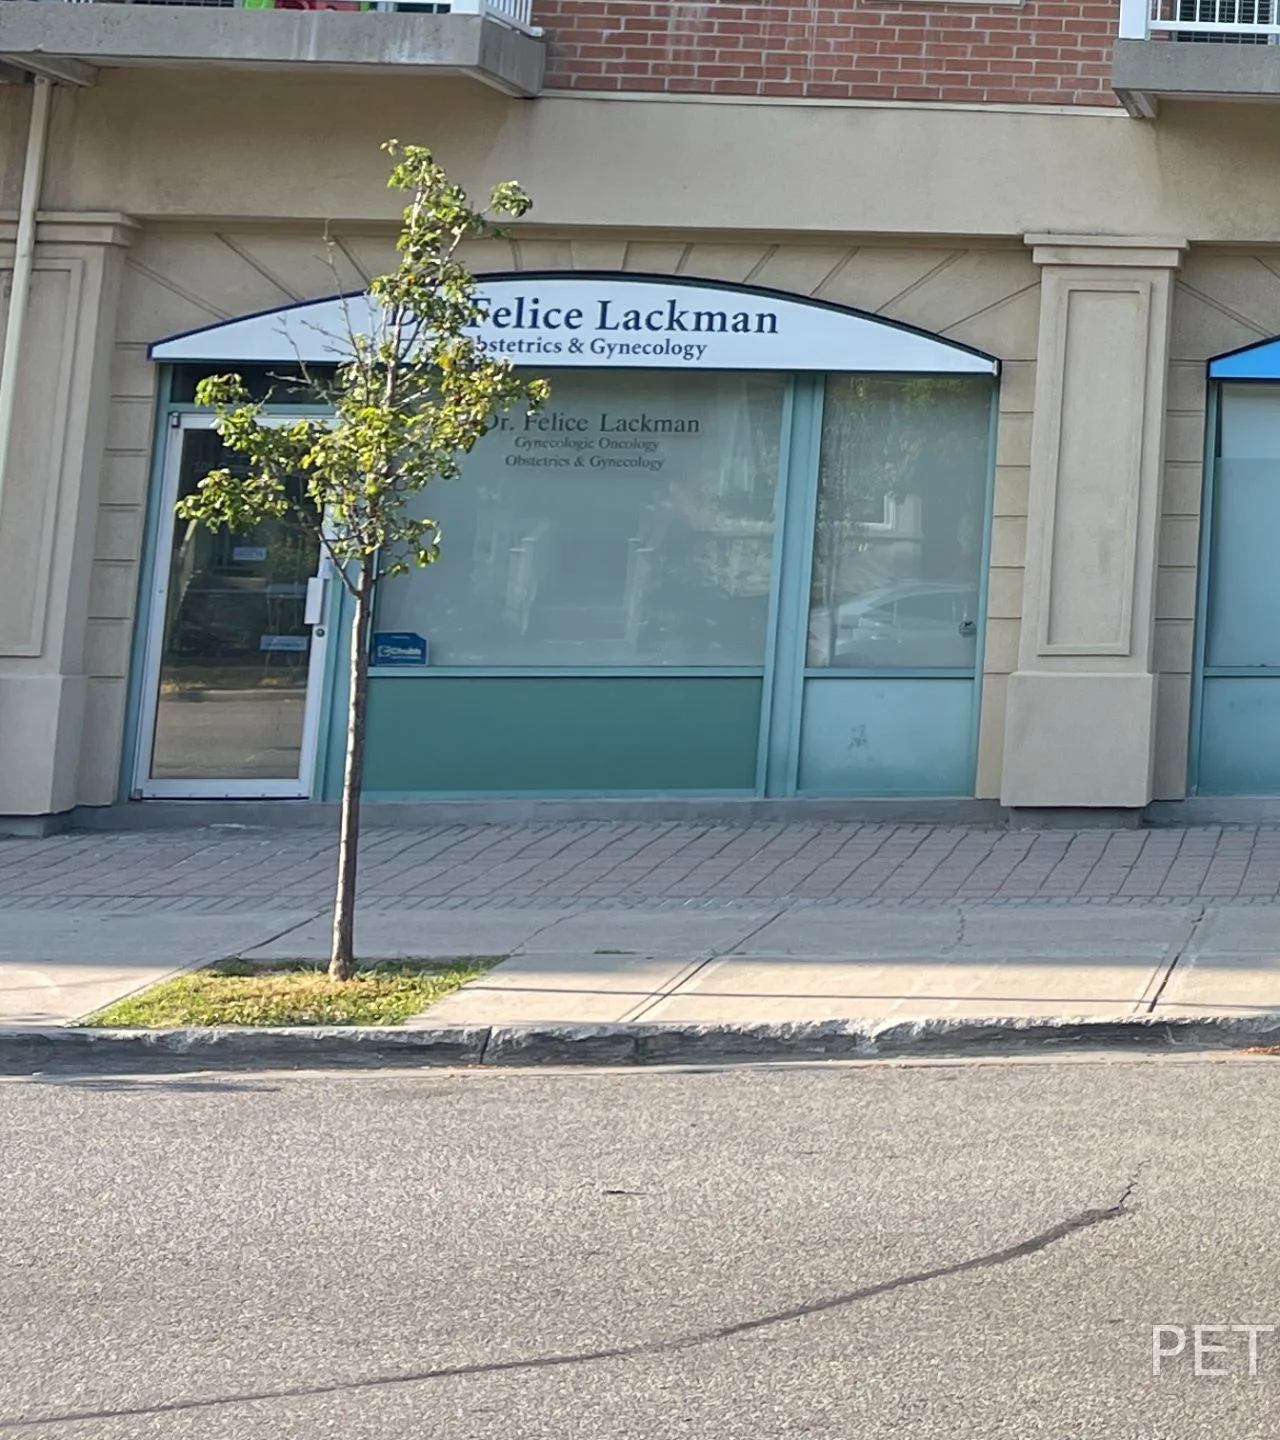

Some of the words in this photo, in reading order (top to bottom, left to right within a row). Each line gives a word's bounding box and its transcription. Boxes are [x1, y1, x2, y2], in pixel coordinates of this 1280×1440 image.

[465, 296, 583, 330] Felice
[595, 299, 779, 335] Lackman
[458, 335, 562, 353] bstetrics
[568, 337, 585, 353] &
[590, 337, 708, 360] Gynecology
[524, 412, 589, 432] Felice
[600, 413, 700, 433] Lackman
[514, 437, 595, 451] Gynecologic
[598, 437, 661, 452] Oncology
[505, 454, 571, 468] Obstetrics
[573, 455, 586, 468] &
[589, 455, 665, 471] Gynecology
